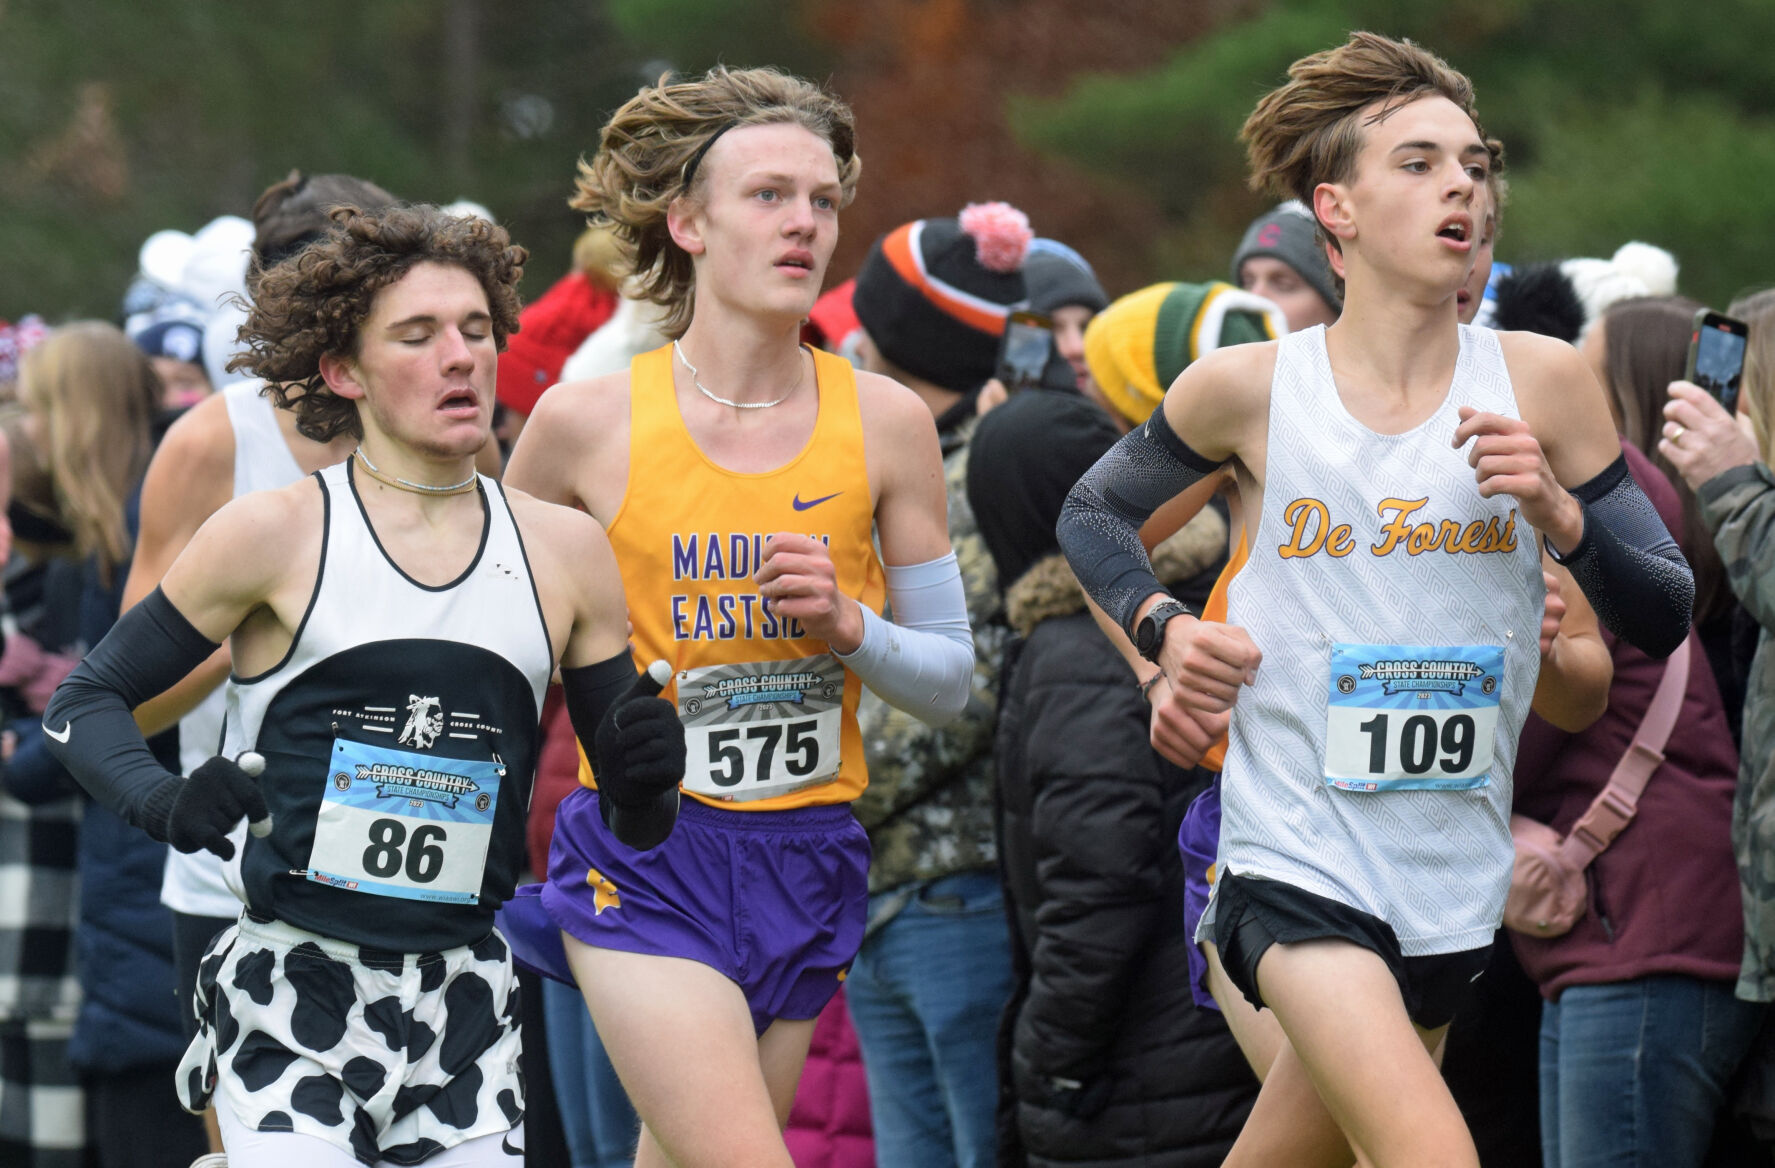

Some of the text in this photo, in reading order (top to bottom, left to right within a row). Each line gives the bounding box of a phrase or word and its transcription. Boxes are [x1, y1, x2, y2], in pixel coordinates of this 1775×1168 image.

[1278, 496, 1518, 559] De Forest
[672, 532, 830, 581] MADI
[718, 672, 814, 697] CROSS COUNTRY
[1376, 660, 1476, 681] CROSS COUNTRY
[1393, 680, 1456, 689] STATE CHAMPIONSHIPS
[735, 692, 797, 704] STATE CHAMPIONSHIPS
[332, 709, 396, 722] FORT ATKINSON
[708, 719, 819, 787] 575
[1360, 713, 1475, 775] 109
[372, 764, 471, 795] CROSS COUNTRY
[387, 784, 450, 802] STATE CHAMPIONSHIPS
[362, 818, 447, 884] 86
